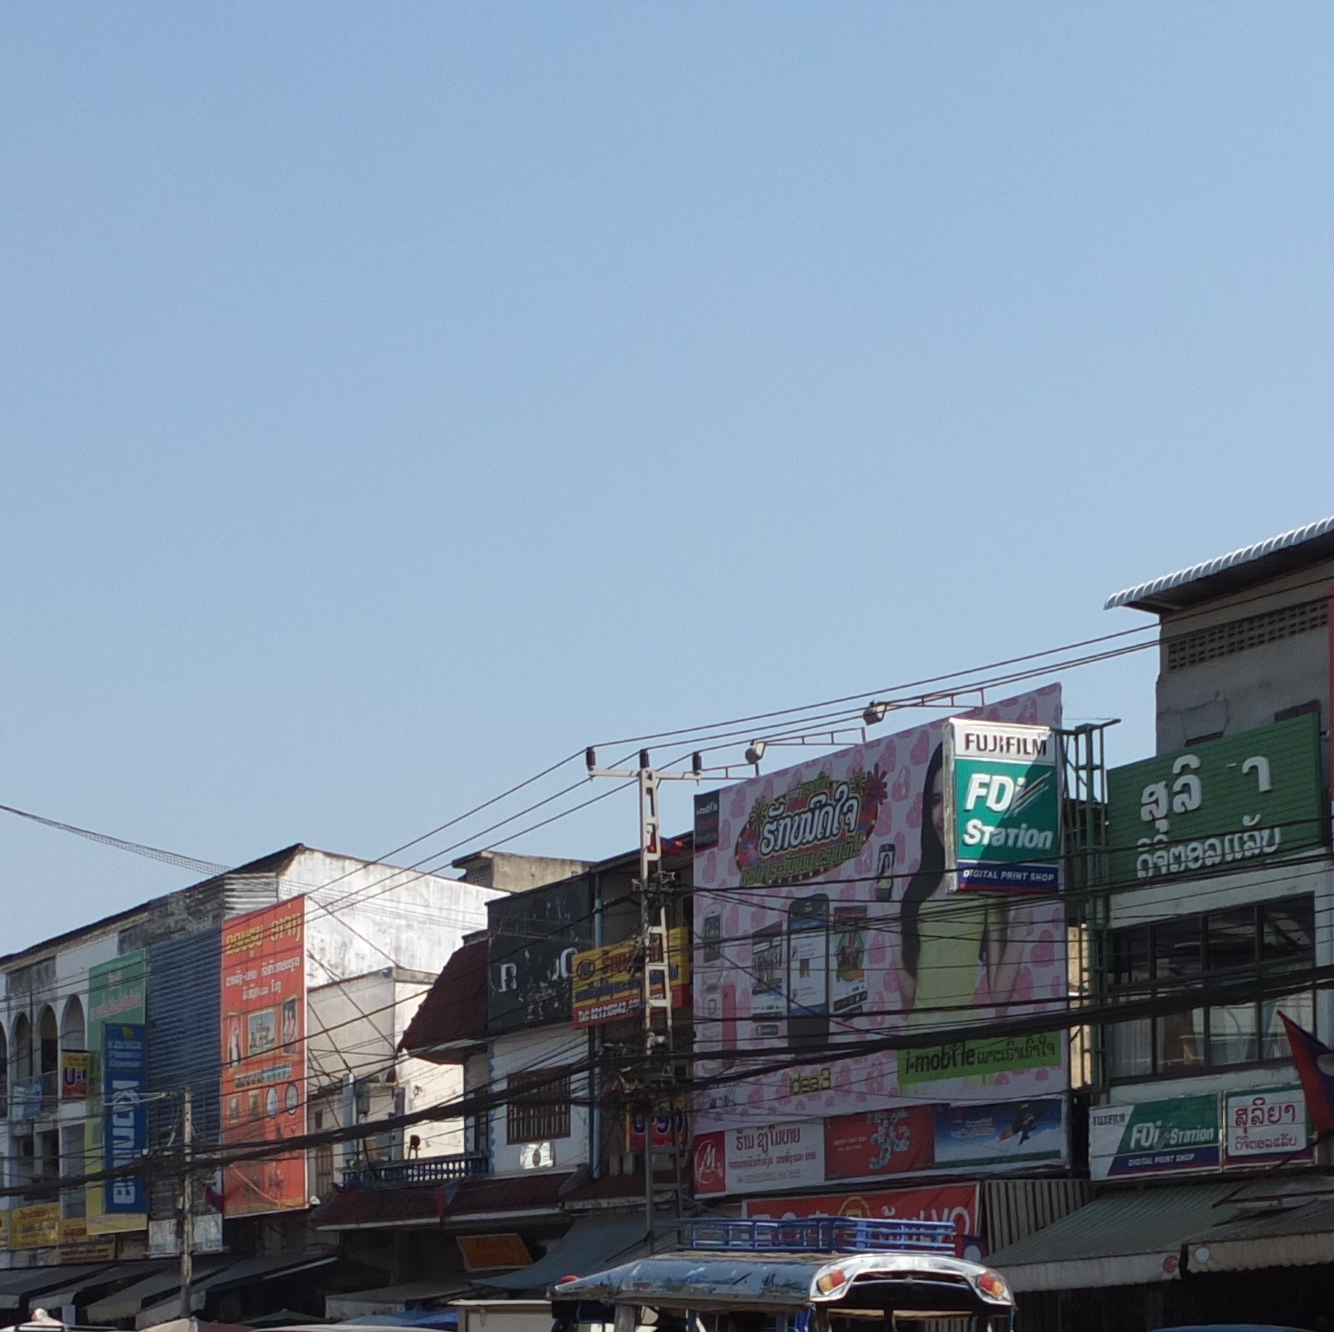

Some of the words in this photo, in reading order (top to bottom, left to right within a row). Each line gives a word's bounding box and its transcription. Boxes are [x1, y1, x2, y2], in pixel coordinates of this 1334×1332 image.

[965, 732, 1047, 756] FUJIFILM
[964, 773, 1026, 812] FDi
[1141, 754, 1272, 833] ສຸລິາ
[963, 819, 1054, 850] Station
[963, 869, 997, 879] DIGITAL
[1001, 871, 1029, 881] PRINT
[1030, 873, 1055, 882] SHOP
[904, 1041, 975, 1074] i-mobile
[1093, 1113, 1125, 1126] FUJIFILM
[1235, 1097, 1296, 1134] ສຸລິຍາ
[1130, 1120, 1163, 1149] FDi
[1169, 1125, 1214, 1145] Station
